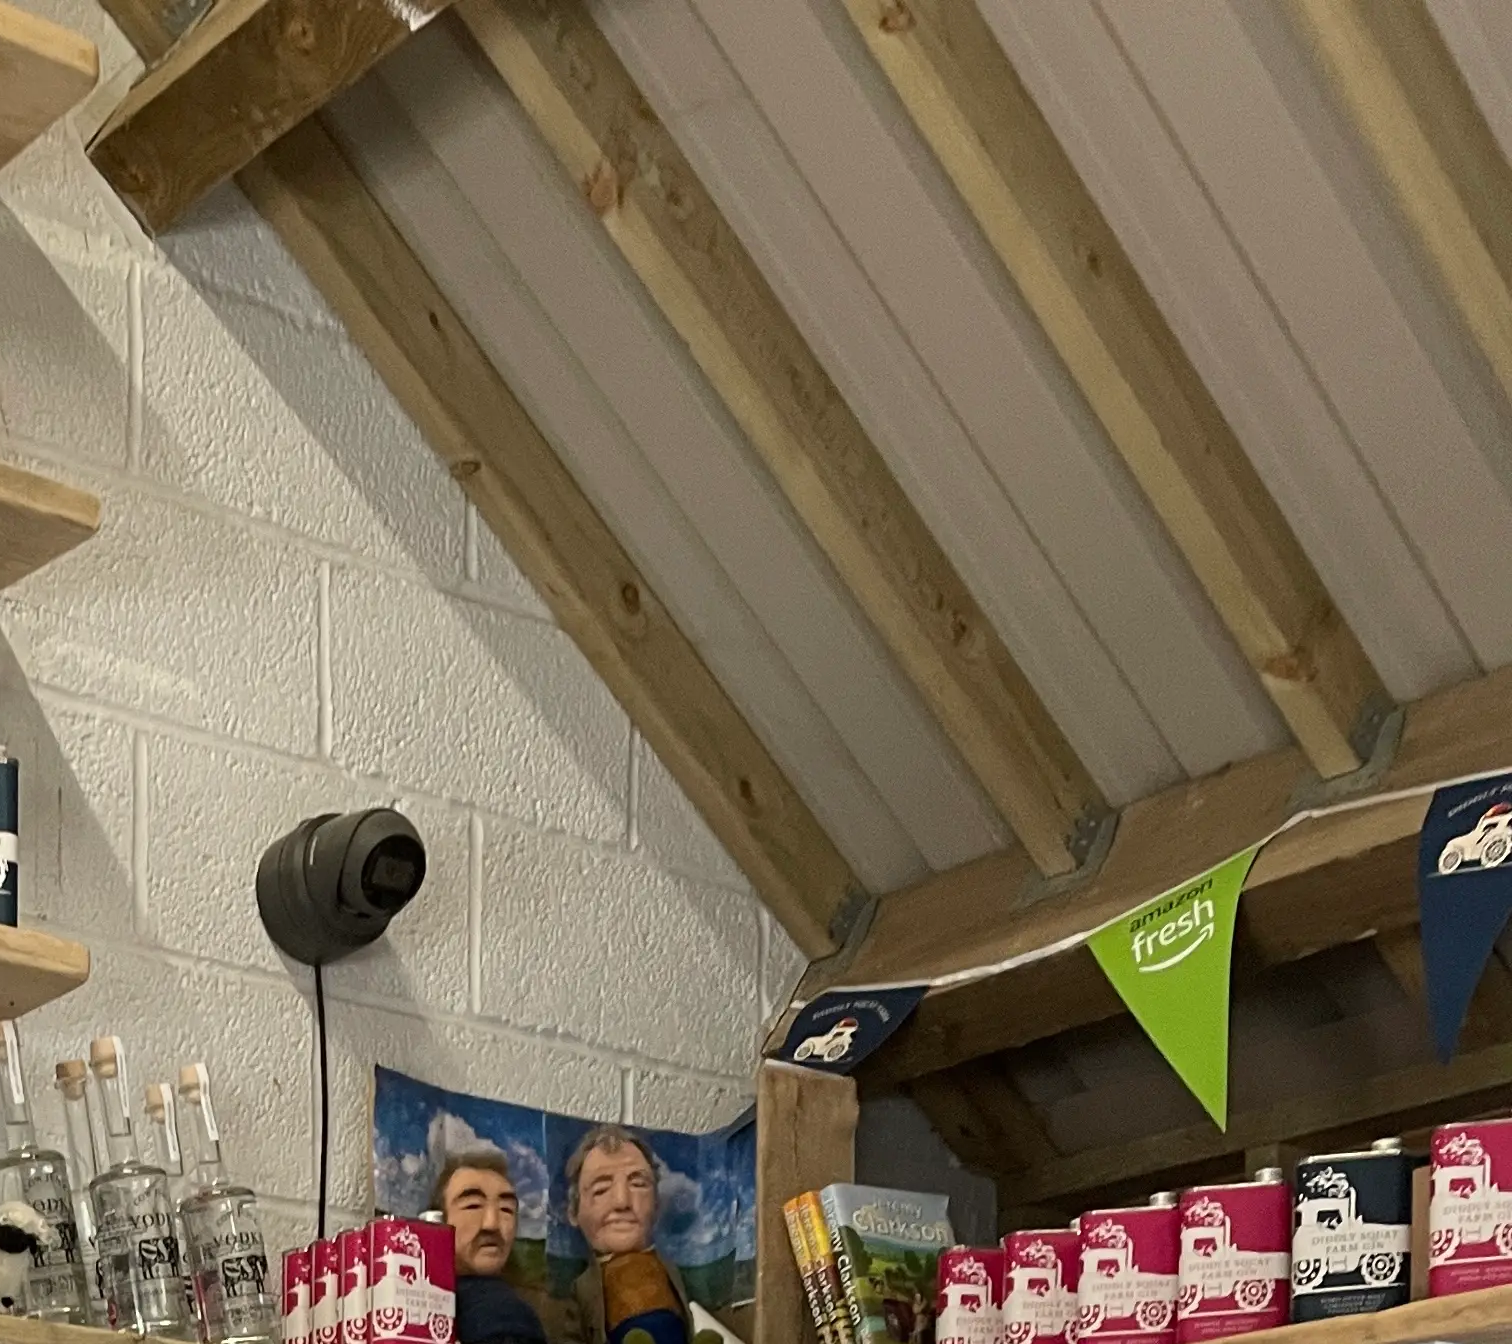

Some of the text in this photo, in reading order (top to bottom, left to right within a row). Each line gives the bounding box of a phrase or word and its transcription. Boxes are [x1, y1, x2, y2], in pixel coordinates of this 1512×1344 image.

[1129, 876, 1214, 933] amazon
[1131, 898, 1215, 964] fresh
[851, 1205, 951, 1245] Clarkson
[800, 1262, 825, 1328] Clarkson
[813, 1257, 838, 1324] Clarkson
[836, 1256, 862, 1327] Clarkson
